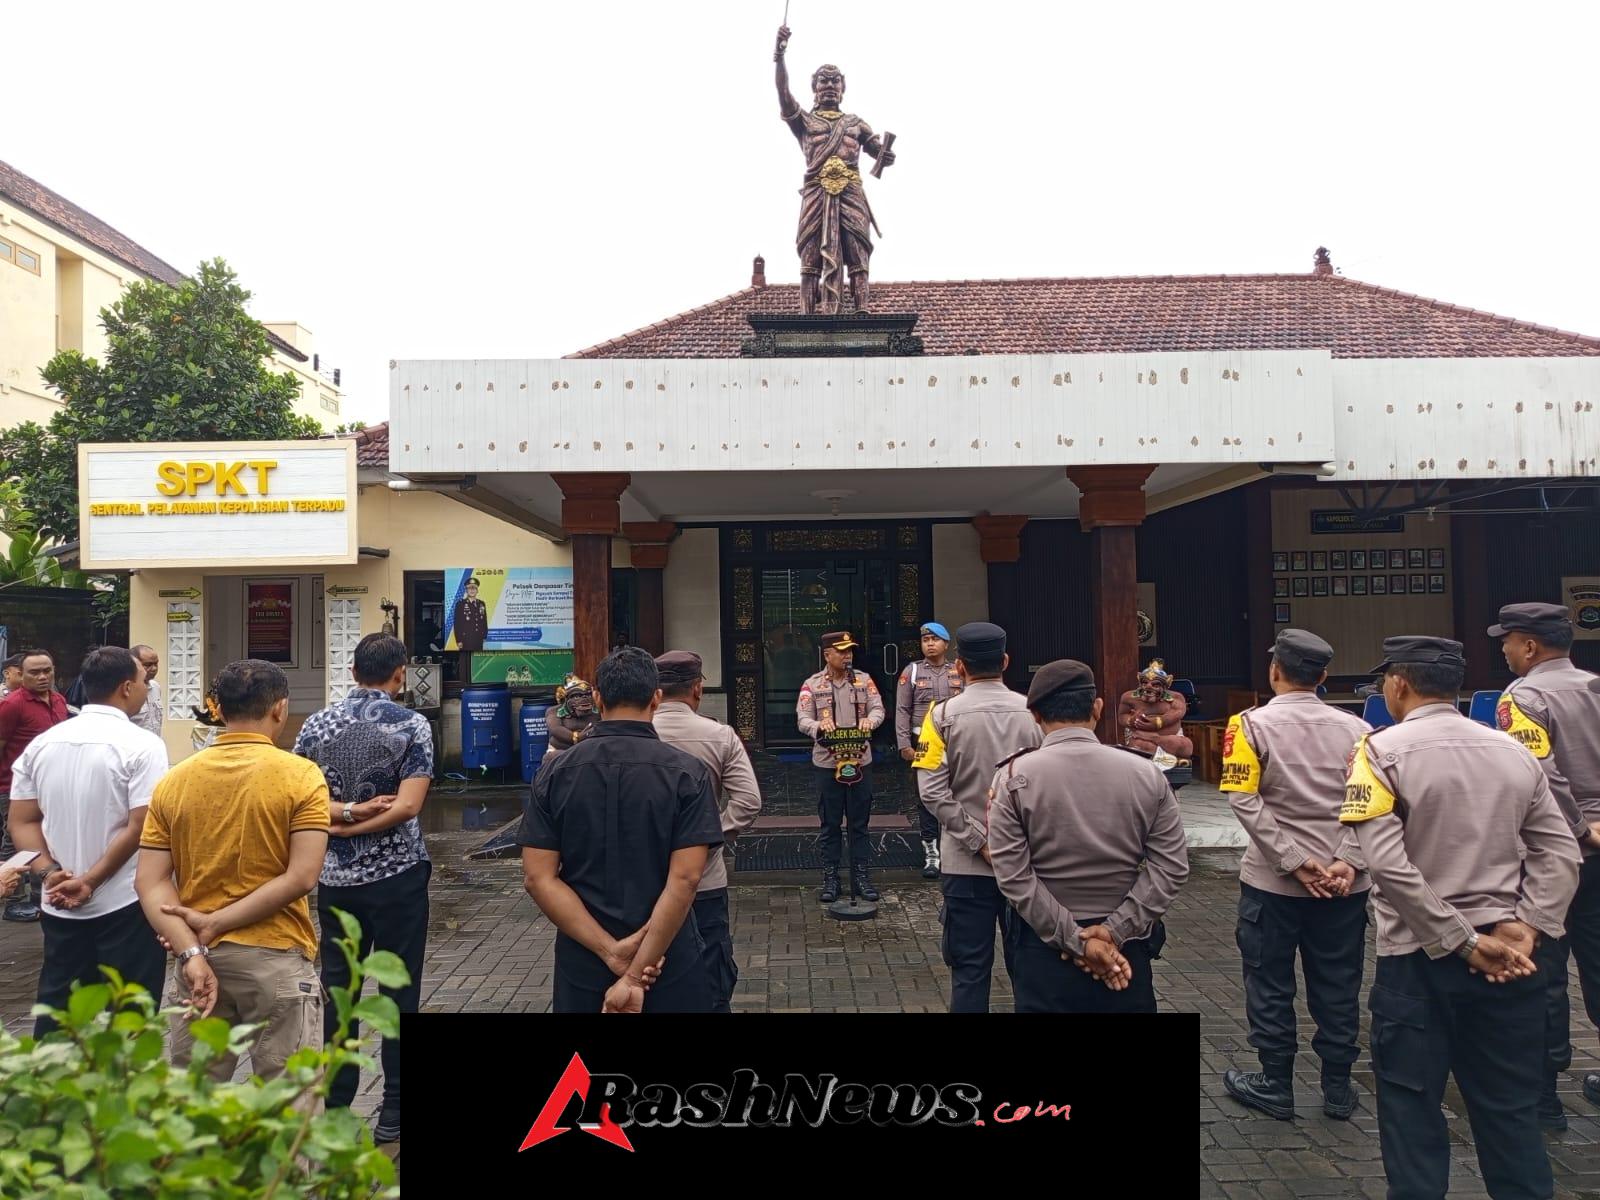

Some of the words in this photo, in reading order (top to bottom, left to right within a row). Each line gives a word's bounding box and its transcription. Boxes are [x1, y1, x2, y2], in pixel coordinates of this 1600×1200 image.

[155, 460, 278, 497] SPKT
[90, 503, 144, 516] SENTRAL
[147, 502, 217, 516] PELAYANAN
[219, 500, 289, 514] KEPOLISIAN
[291, 500, 345, 513] TERPADU
